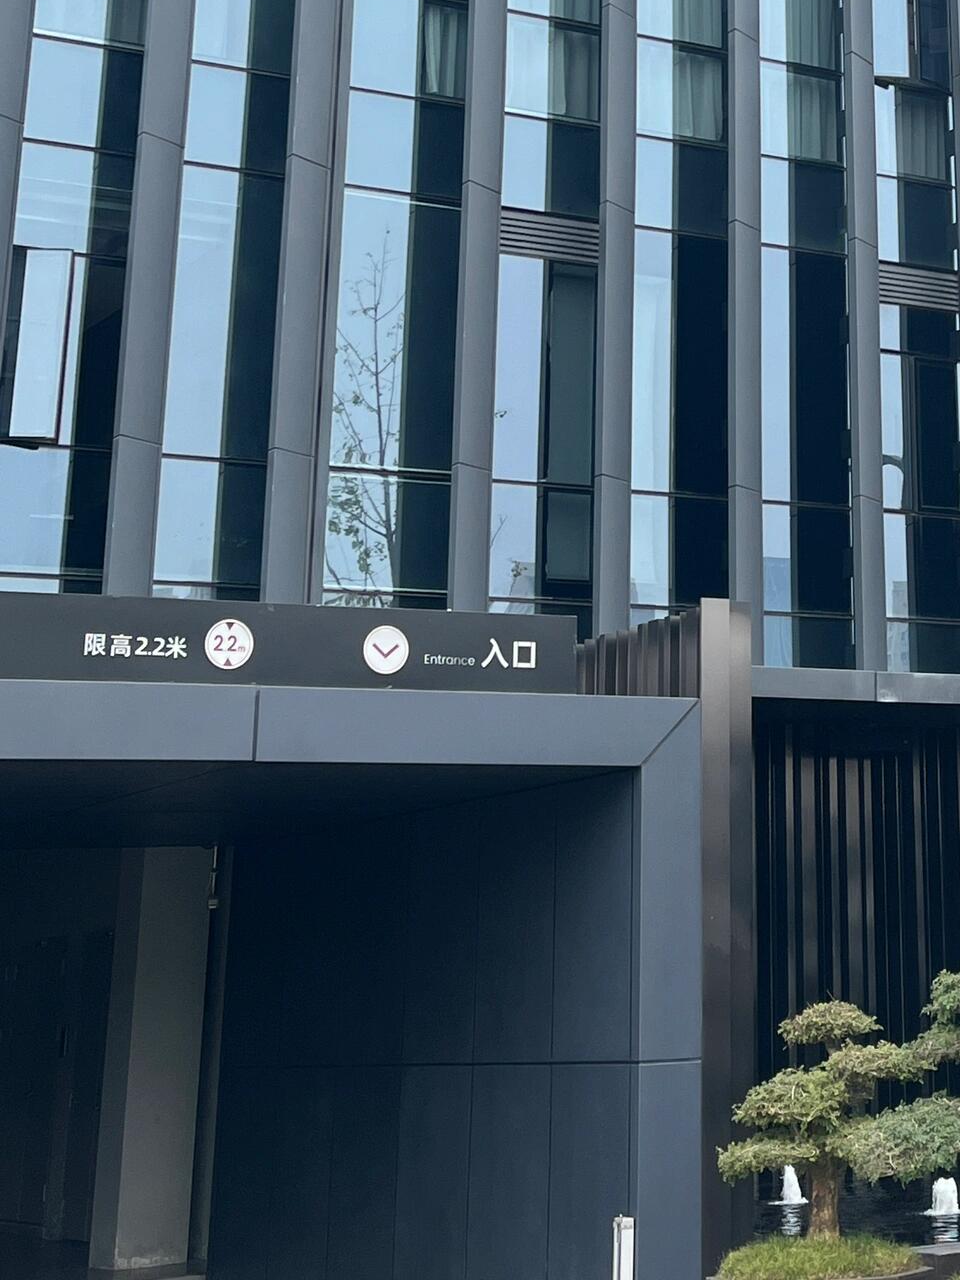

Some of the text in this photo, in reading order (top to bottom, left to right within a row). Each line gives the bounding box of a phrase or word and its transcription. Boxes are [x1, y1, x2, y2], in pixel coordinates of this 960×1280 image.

[83, 632, 188, 659] 限高2.2米
[481, 637, 537, 669] 入口
[423, 653, 476, 666] Entrance
